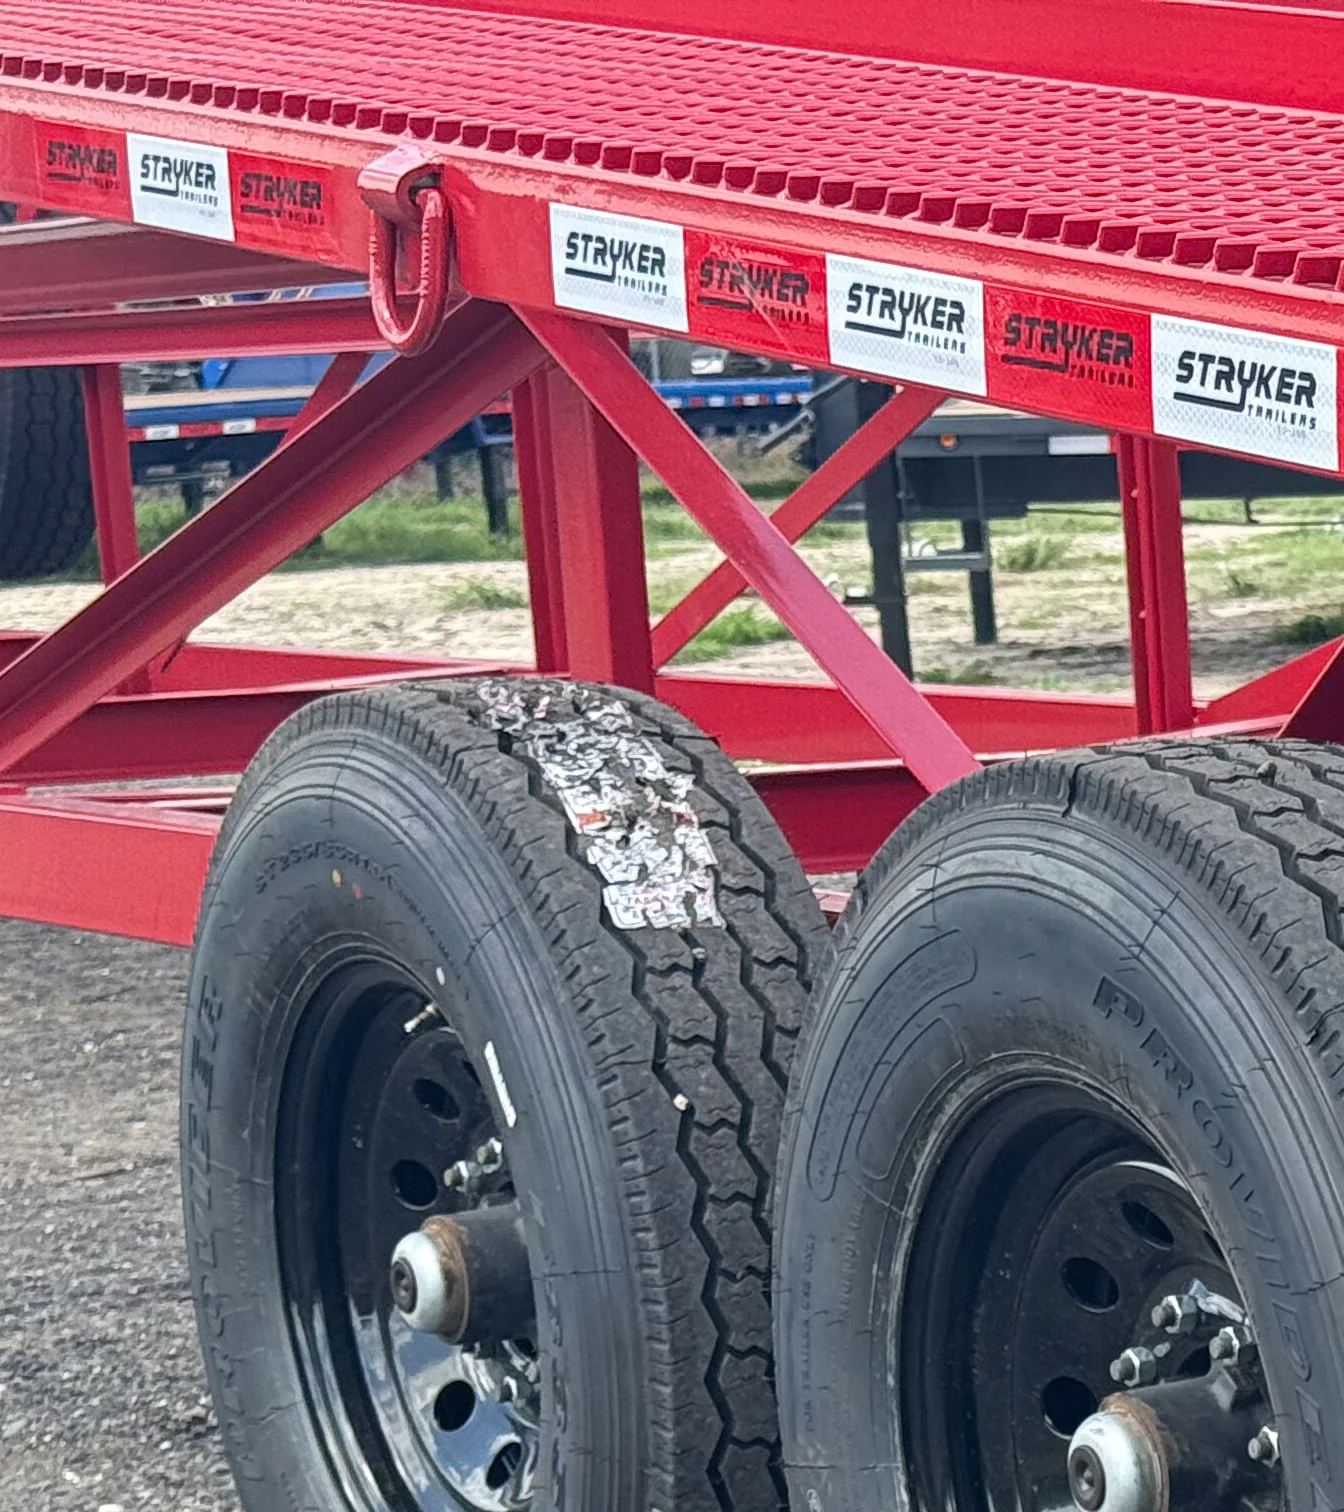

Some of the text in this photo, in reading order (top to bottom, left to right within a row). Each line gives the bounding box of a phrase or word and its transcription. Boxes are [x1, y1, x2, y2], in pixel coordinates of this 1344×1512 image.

[140, 154, 217, 197] STRYKER
[239, 172, 322, 217] STRYKER
[565, 231, 666, 282] STRYKER
[697, 256, 809, 311] STRYKER
[845, 282, 966, 339] STRYKER
[907, 331, 966, 354] TRAILERS
[1001, 313, 1134, 373] STRYKER
[1174, 350, 1317, 412] STRYKER
[1247, 403, 1317, 430] TRAILERS
